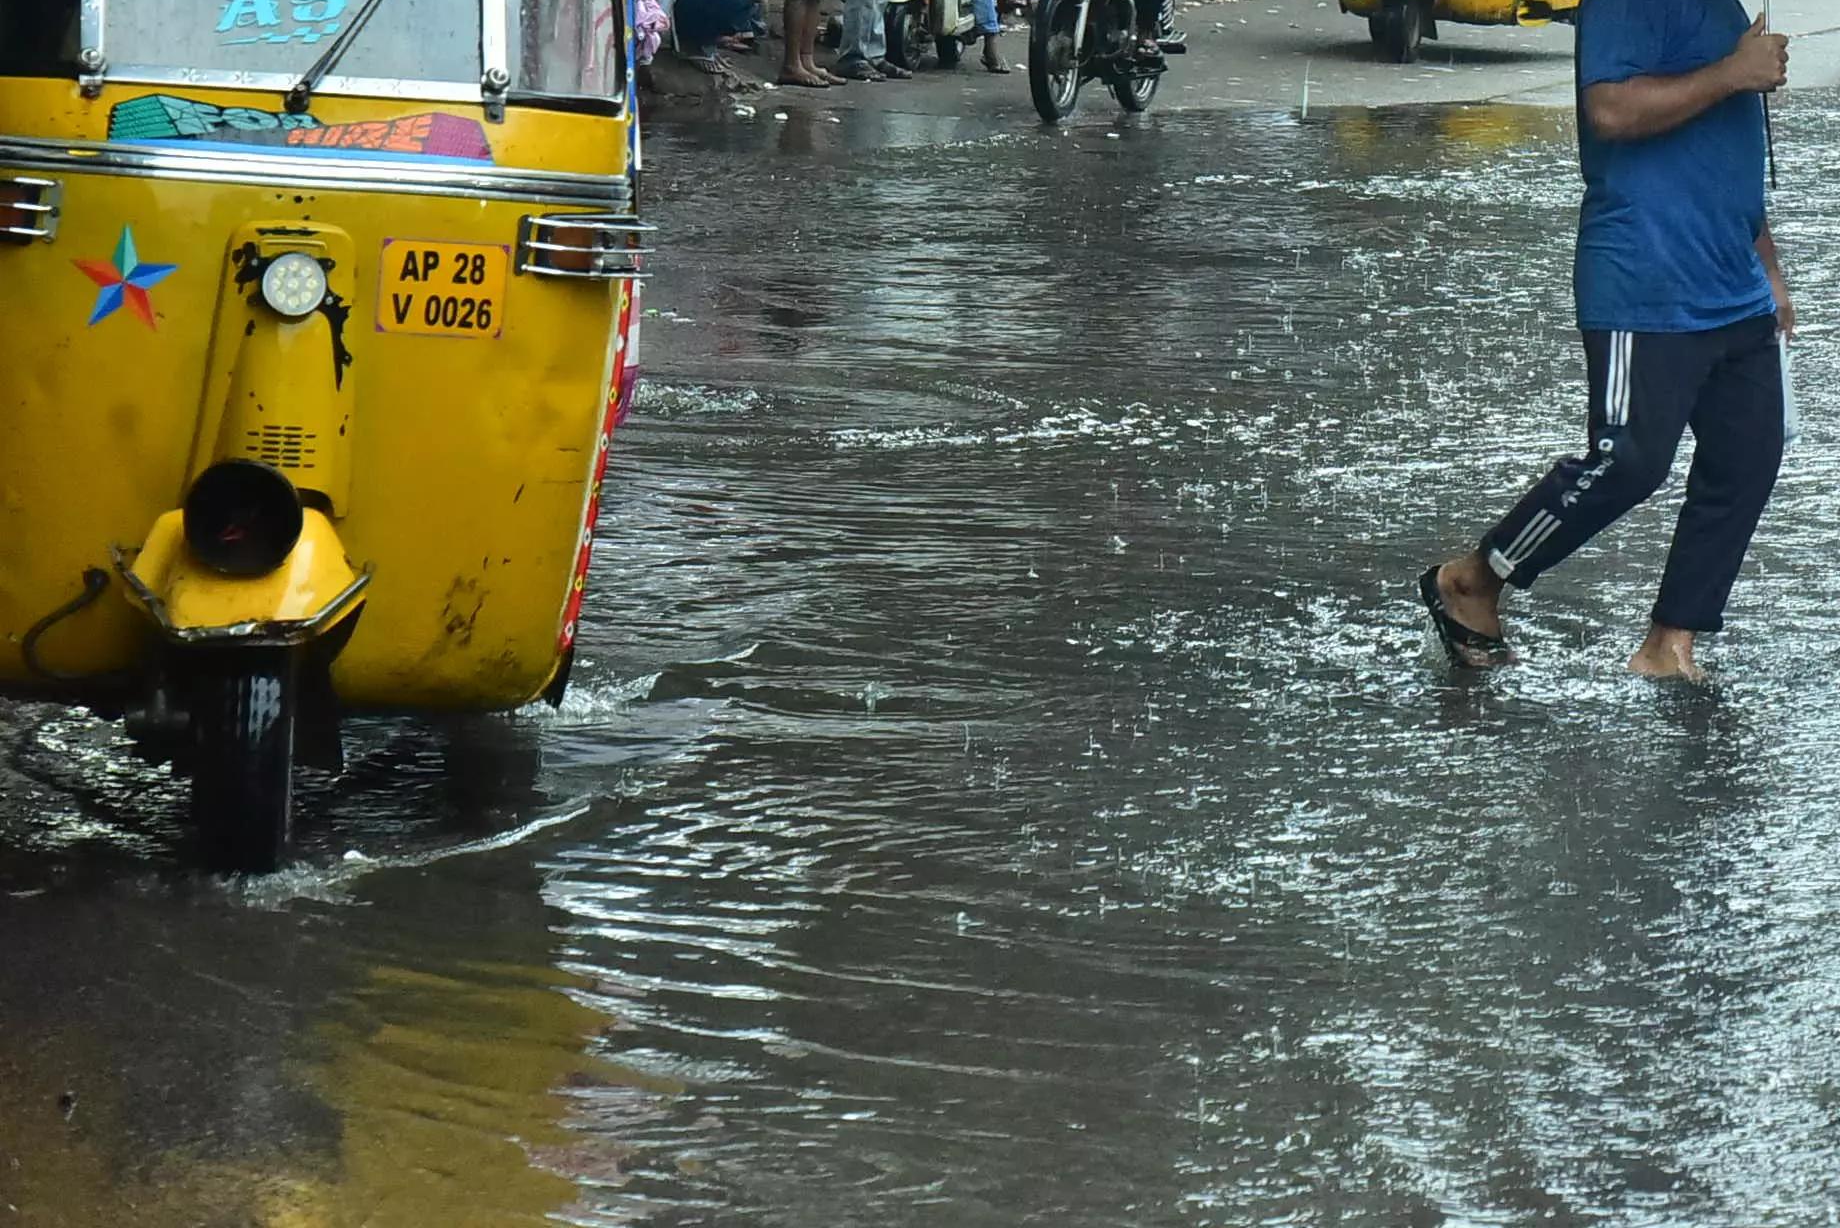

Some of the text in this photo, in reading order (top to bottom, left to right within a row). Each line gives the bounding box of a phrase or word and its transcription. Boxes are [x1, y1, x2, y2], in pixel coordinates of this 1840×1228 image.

[162, 94, 434, 152] FOR HIRE
[399, 249, 486, 285] AP 28
[391, 293, 492, 331] V 0026
